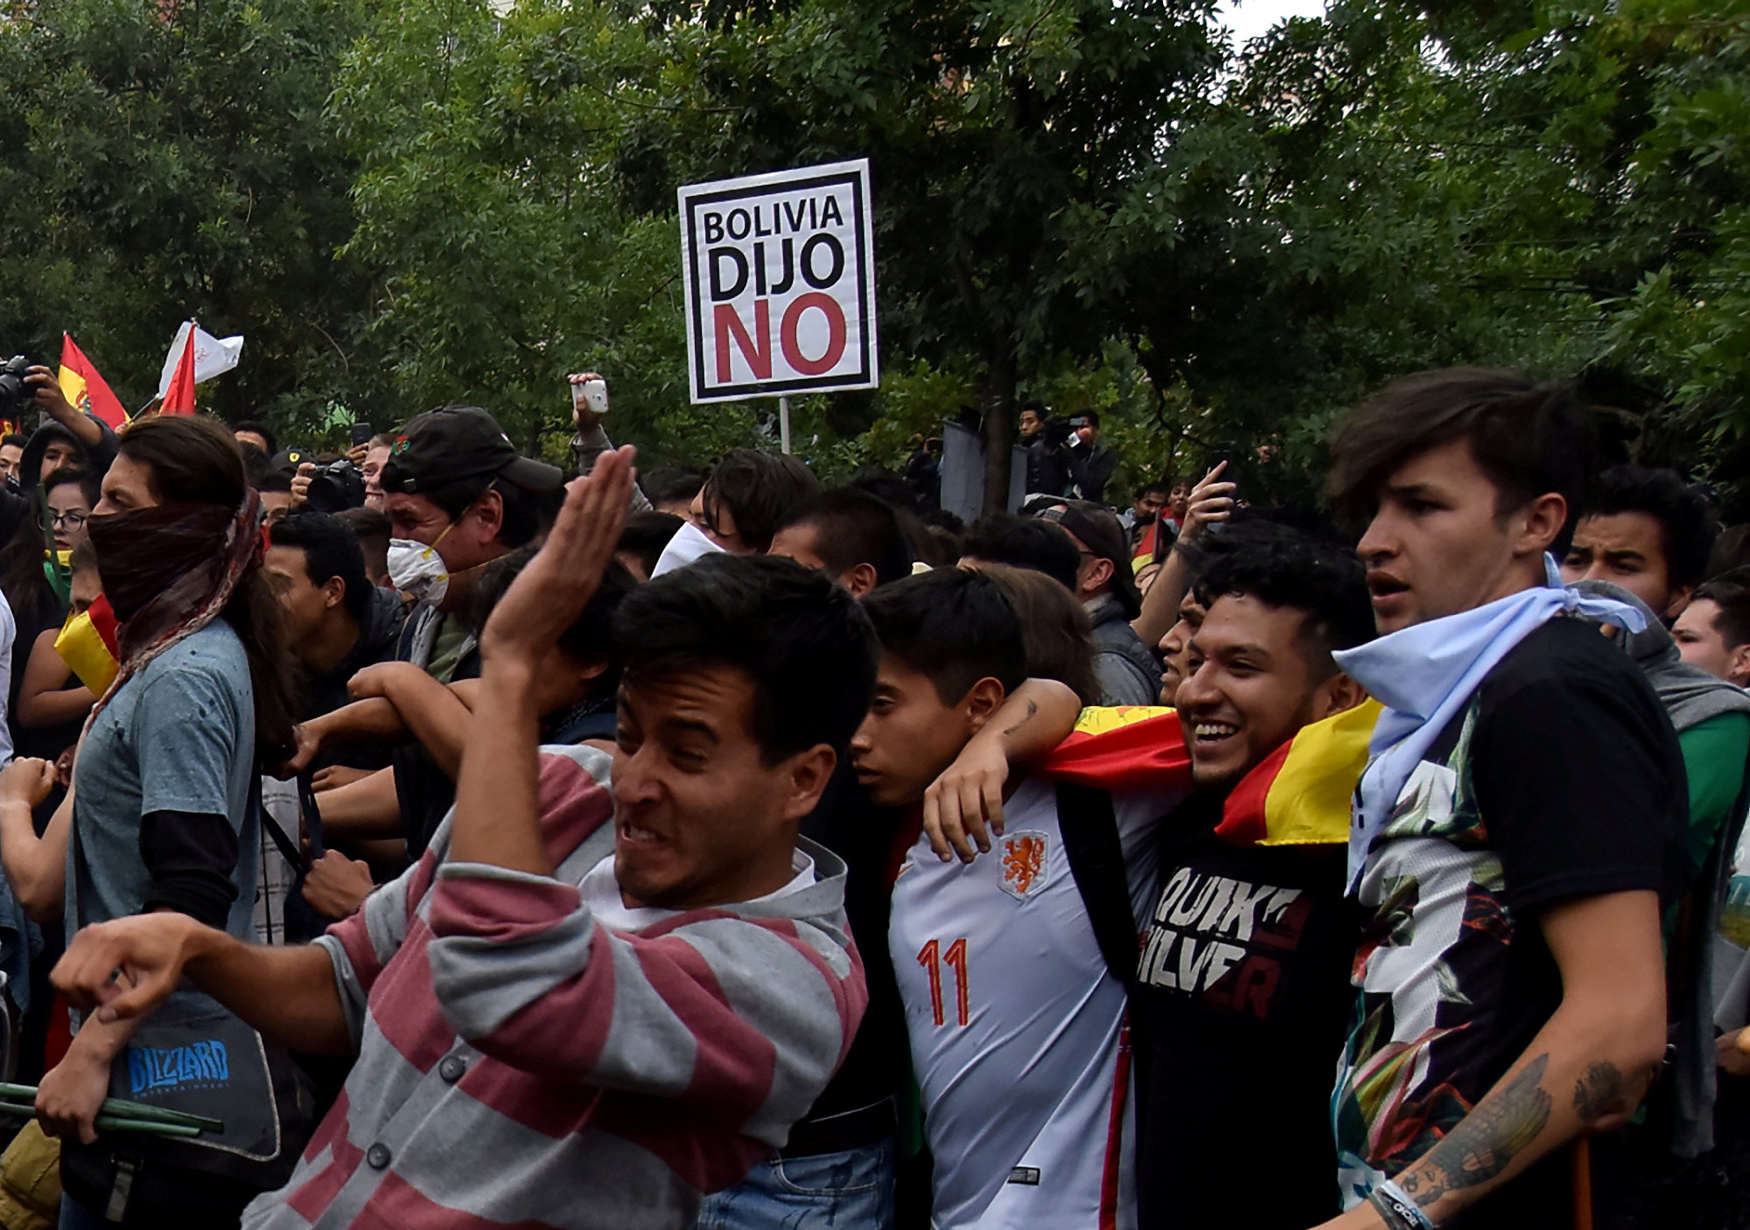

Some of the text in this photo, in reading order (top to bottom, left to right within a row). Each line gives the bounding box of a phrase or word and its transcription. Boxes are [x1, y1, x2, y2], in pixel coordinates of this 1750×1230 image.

[704, 195, 844, 244] BOLIVIA
[708, 232, 845, 302] DIJO
[713, 291, 847, 384] NO
[917, 938, 969, 1027] 11
[129, 1039, 229, 1094] BLIZZARD
